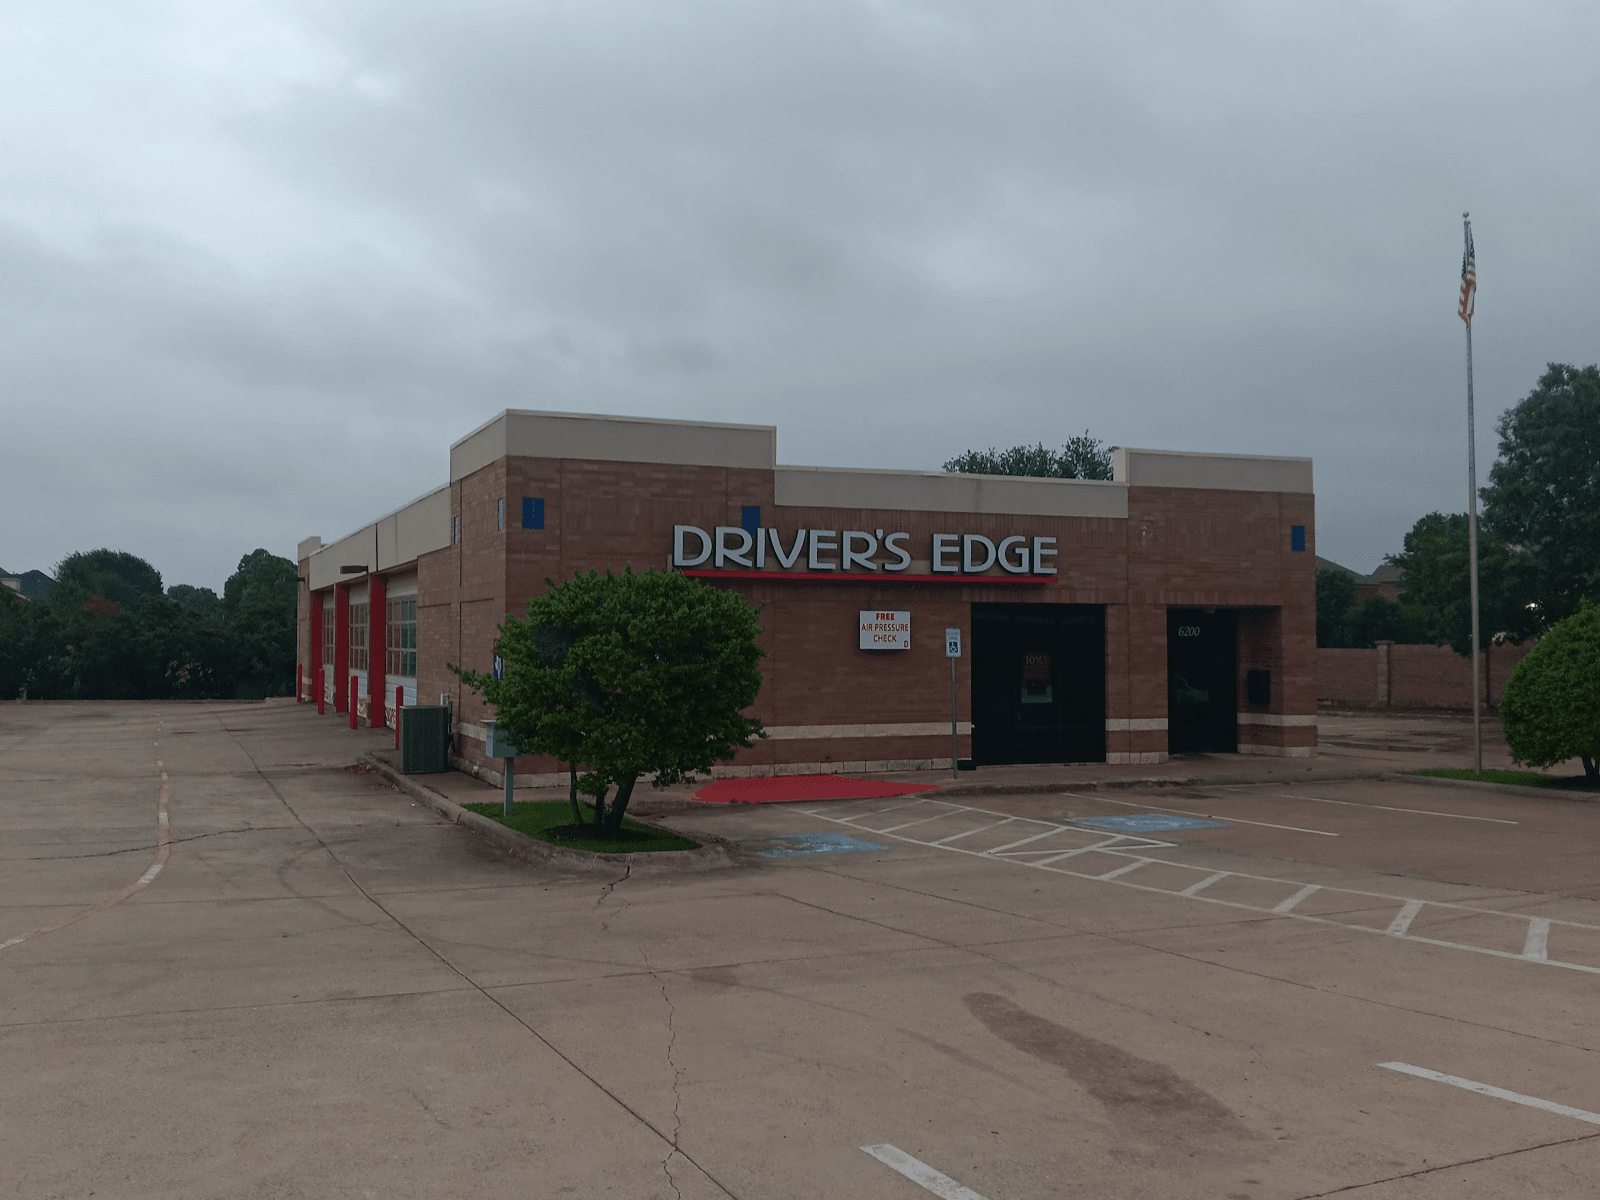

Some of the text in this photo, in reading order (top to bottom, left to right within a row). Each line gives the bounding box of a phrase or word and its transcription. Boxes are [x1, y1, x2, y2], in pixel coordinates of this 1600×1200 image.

[673, 524, 1059, 575] DRIVER'S EDGE
[876, 612, 895, 621] FREE
[861, 623, 909, 632] AIR PRESSURE
[1178, 625, 1201, 637] 6200
[873, 634, 897, 643] CHECK
